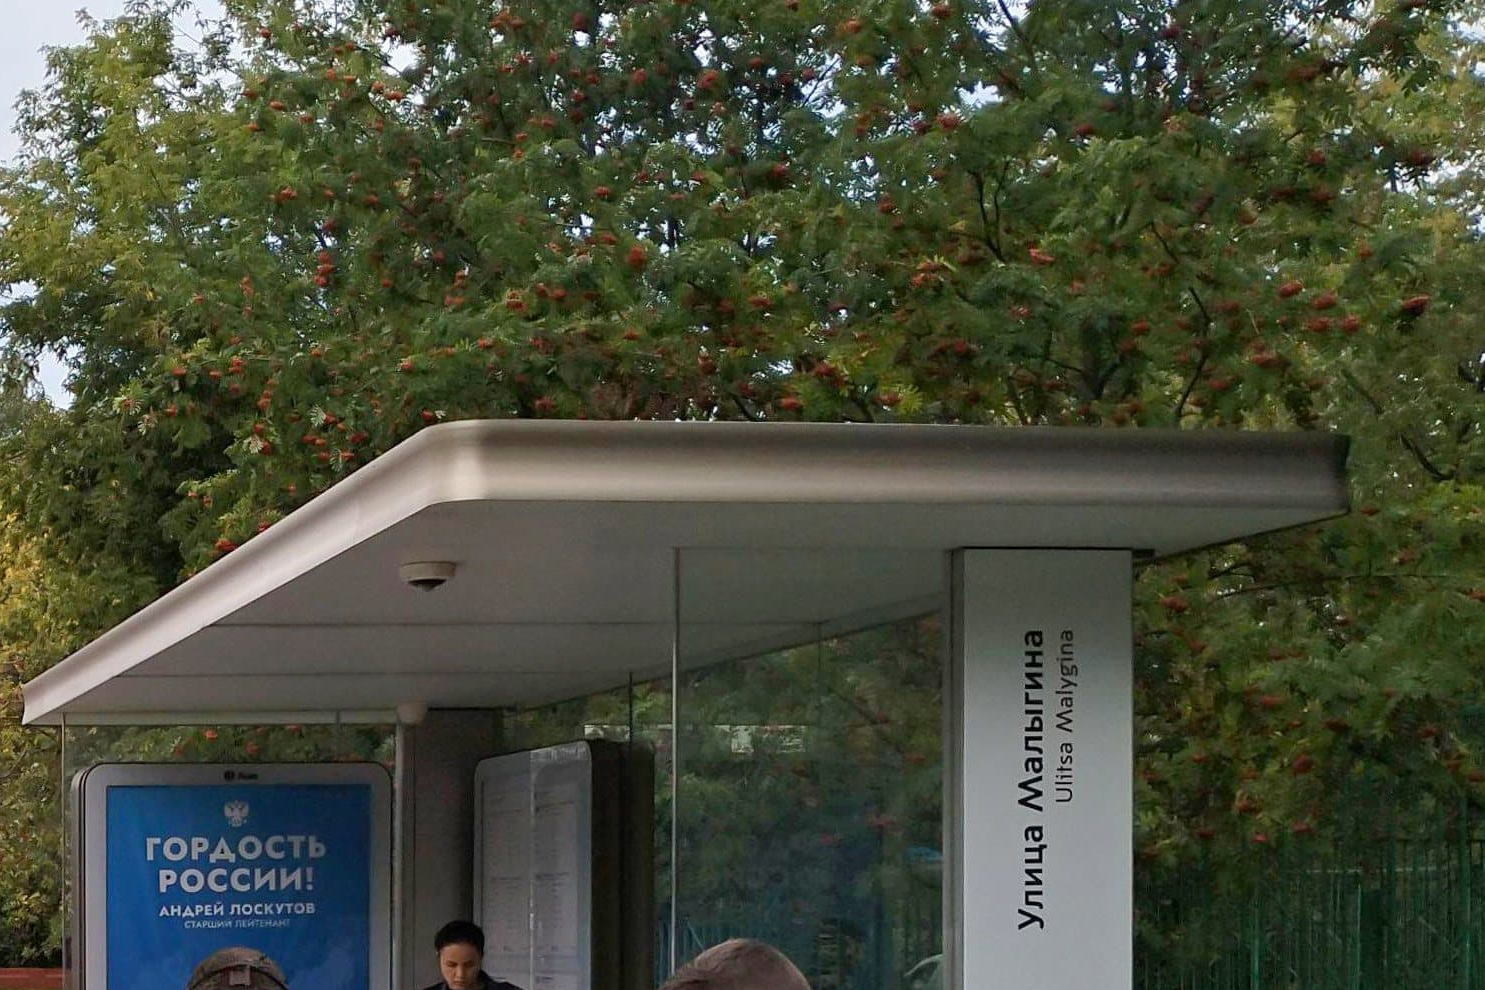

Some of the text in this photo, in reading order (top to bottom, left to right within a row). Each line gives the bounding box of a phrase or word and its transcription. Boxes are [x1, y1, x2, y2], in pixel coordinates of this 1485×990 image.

[1055, 630, 1078, 803] Ulitsa Malygina
[1018, 630, 1047, 930] Улица Малыгина
[146, 835, 327, 863] ГОРДОСТЬ
[158, 866, 315, 893] РОССИИ!
[159, 901, 316, 918] АНДРЕЙ ЛОСКУТОВ
